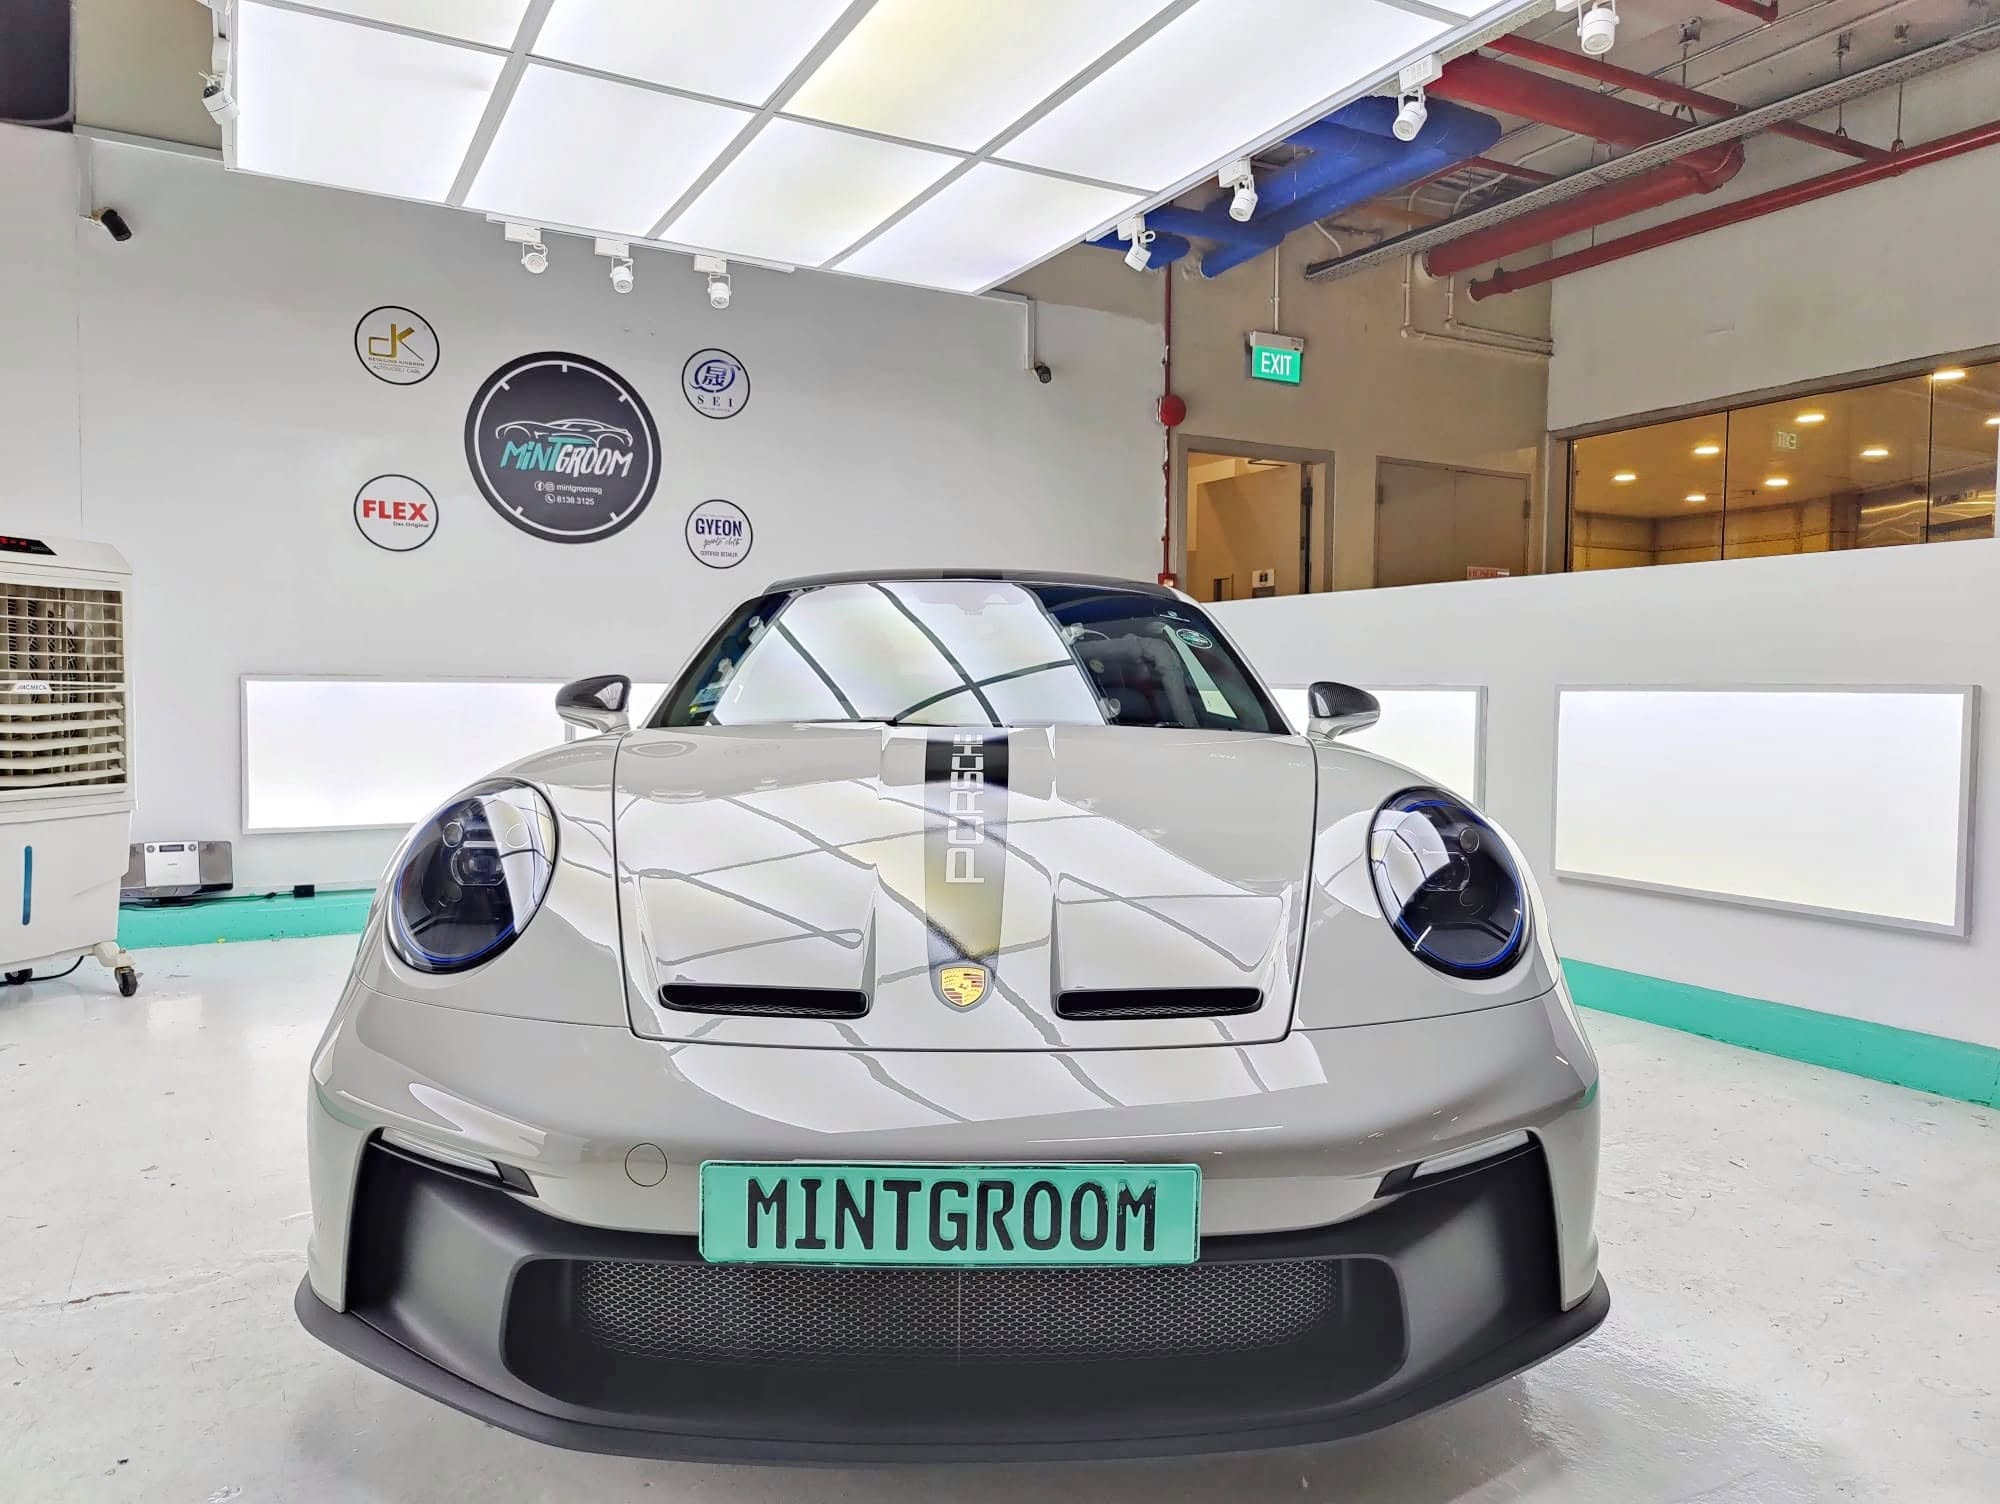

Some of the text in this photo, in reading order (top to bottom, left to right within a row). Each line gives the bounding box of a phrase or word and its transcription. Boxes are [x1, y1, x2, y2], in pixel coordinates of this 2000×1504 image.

[1261, 351, 1293, 376] EXIT
[556, 484, 603, 495] mintgroomsg
[556, 495, 595, 506] 8138 3125
[363, 499, 429, 522] FLEX
[695, 518, 742, 537] GYEON
[945, 734, 985, 884] PORSCHE
[747, 1178, 1157, 1252] MINTGROOM
